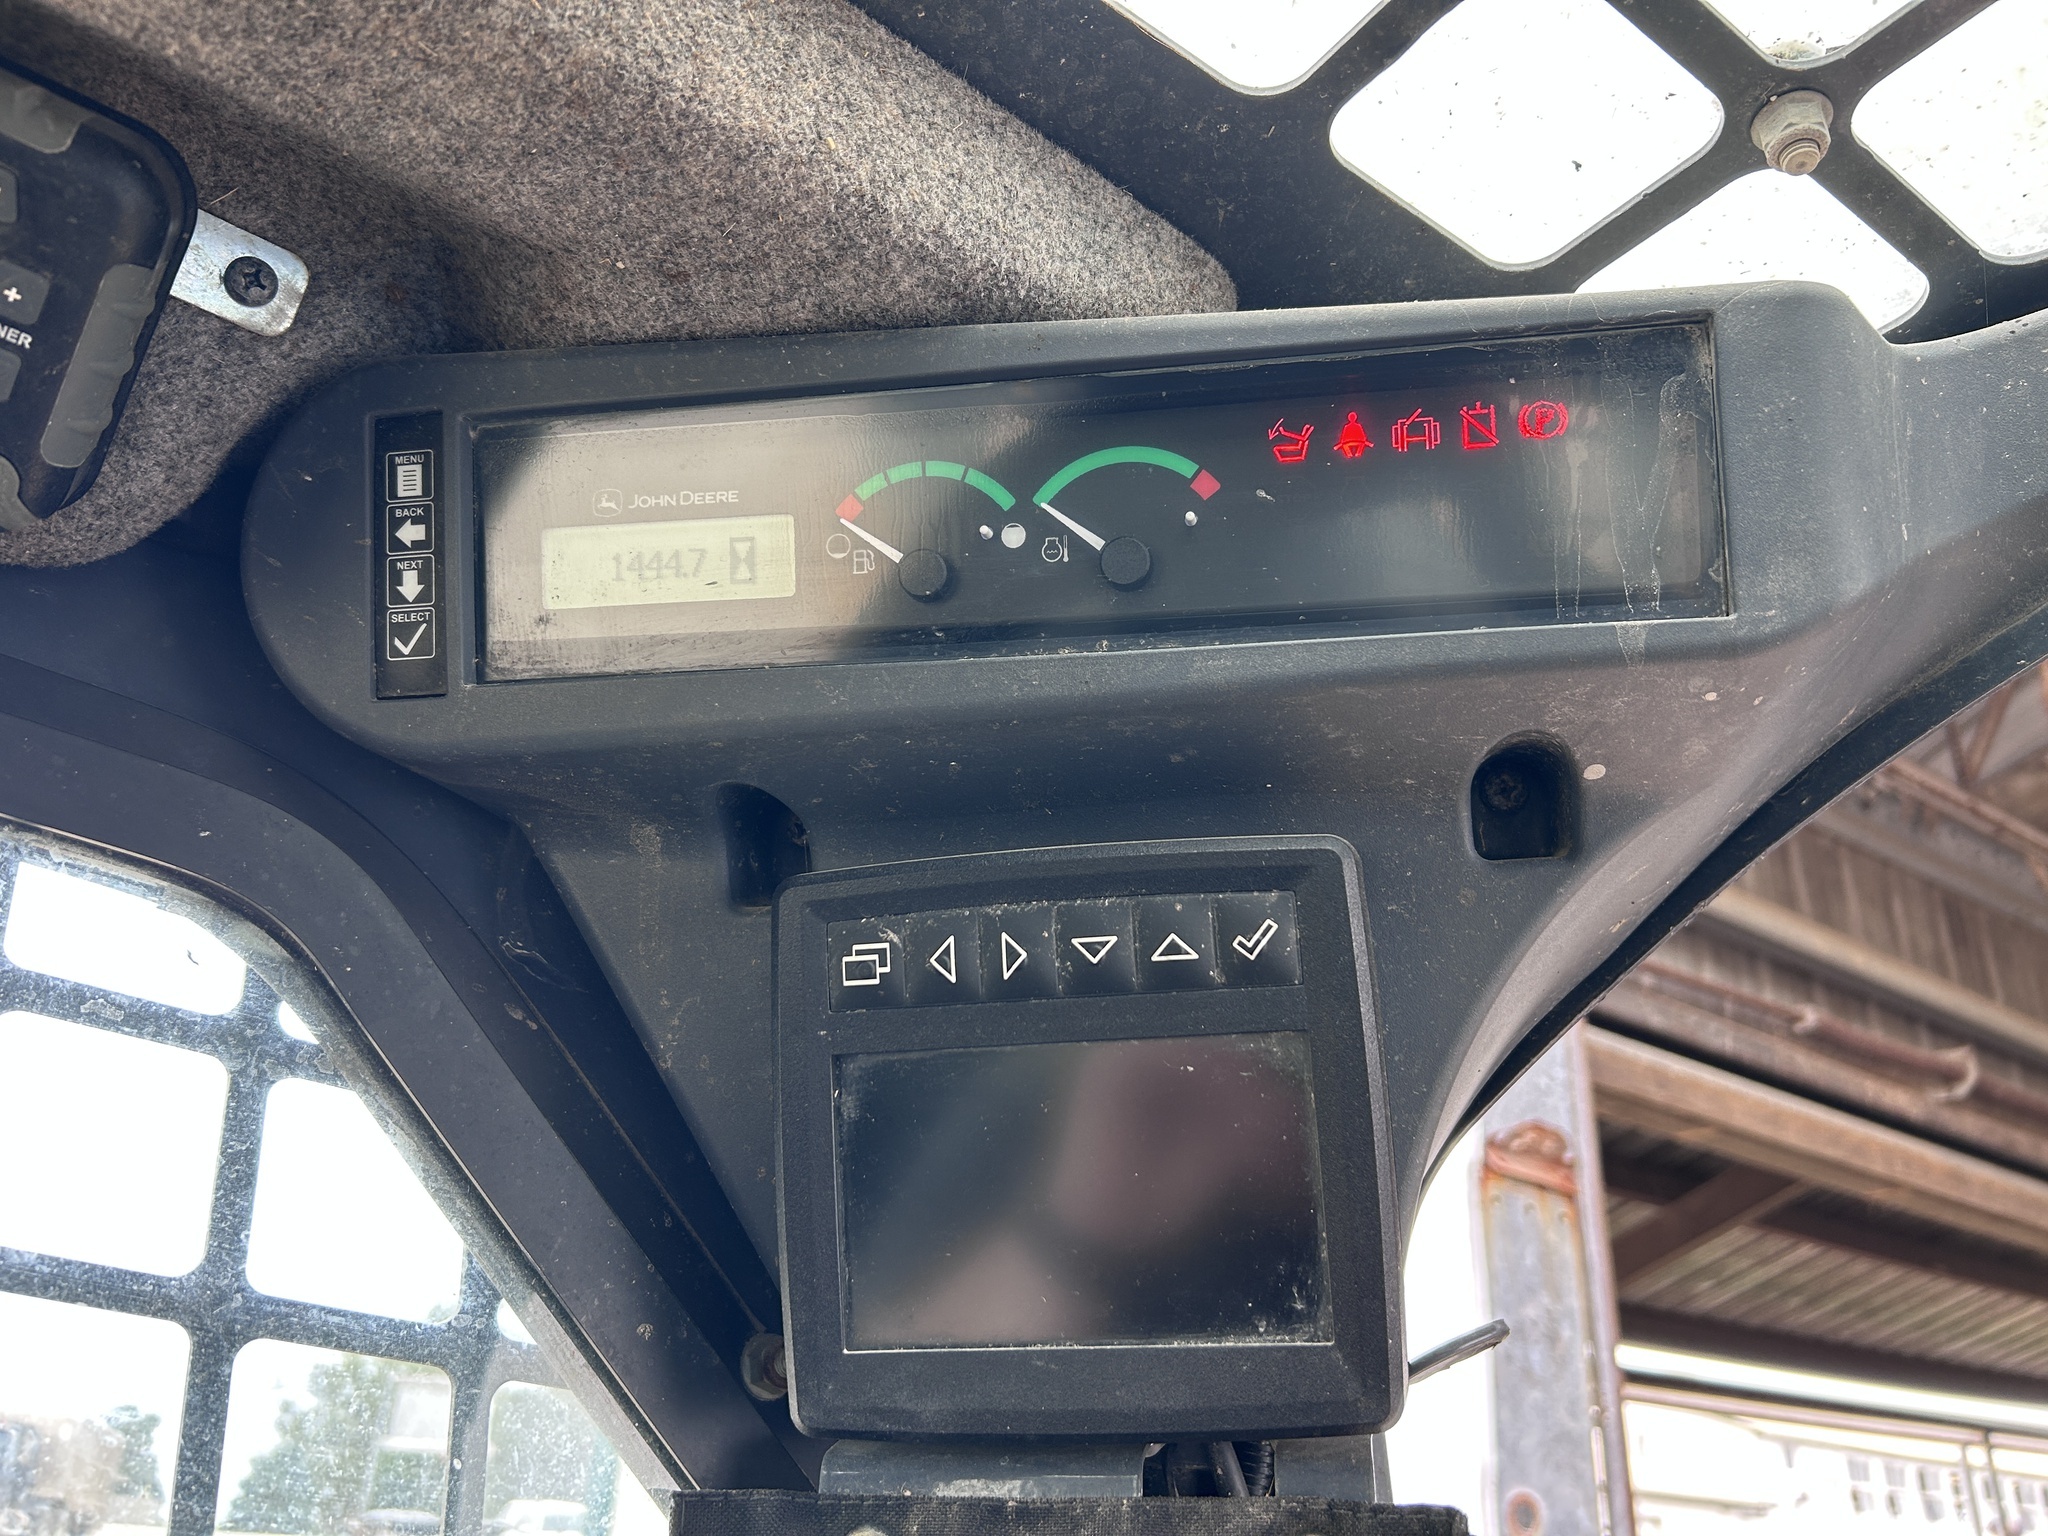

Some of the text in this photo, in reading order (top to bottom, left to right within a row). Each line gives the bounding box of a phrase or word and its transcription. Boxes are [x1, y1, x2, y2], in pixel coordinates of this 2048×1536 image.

[395, 454, 425, 464] MENU
[628, 490, 740, 509] JOHN DEERE
[395, 506, 425, 517] BACK
[396, 559, 424, 570] NEXT
[611, 547, 708, 582] 1444.7
[391, 611, 431, 623] SELECT
